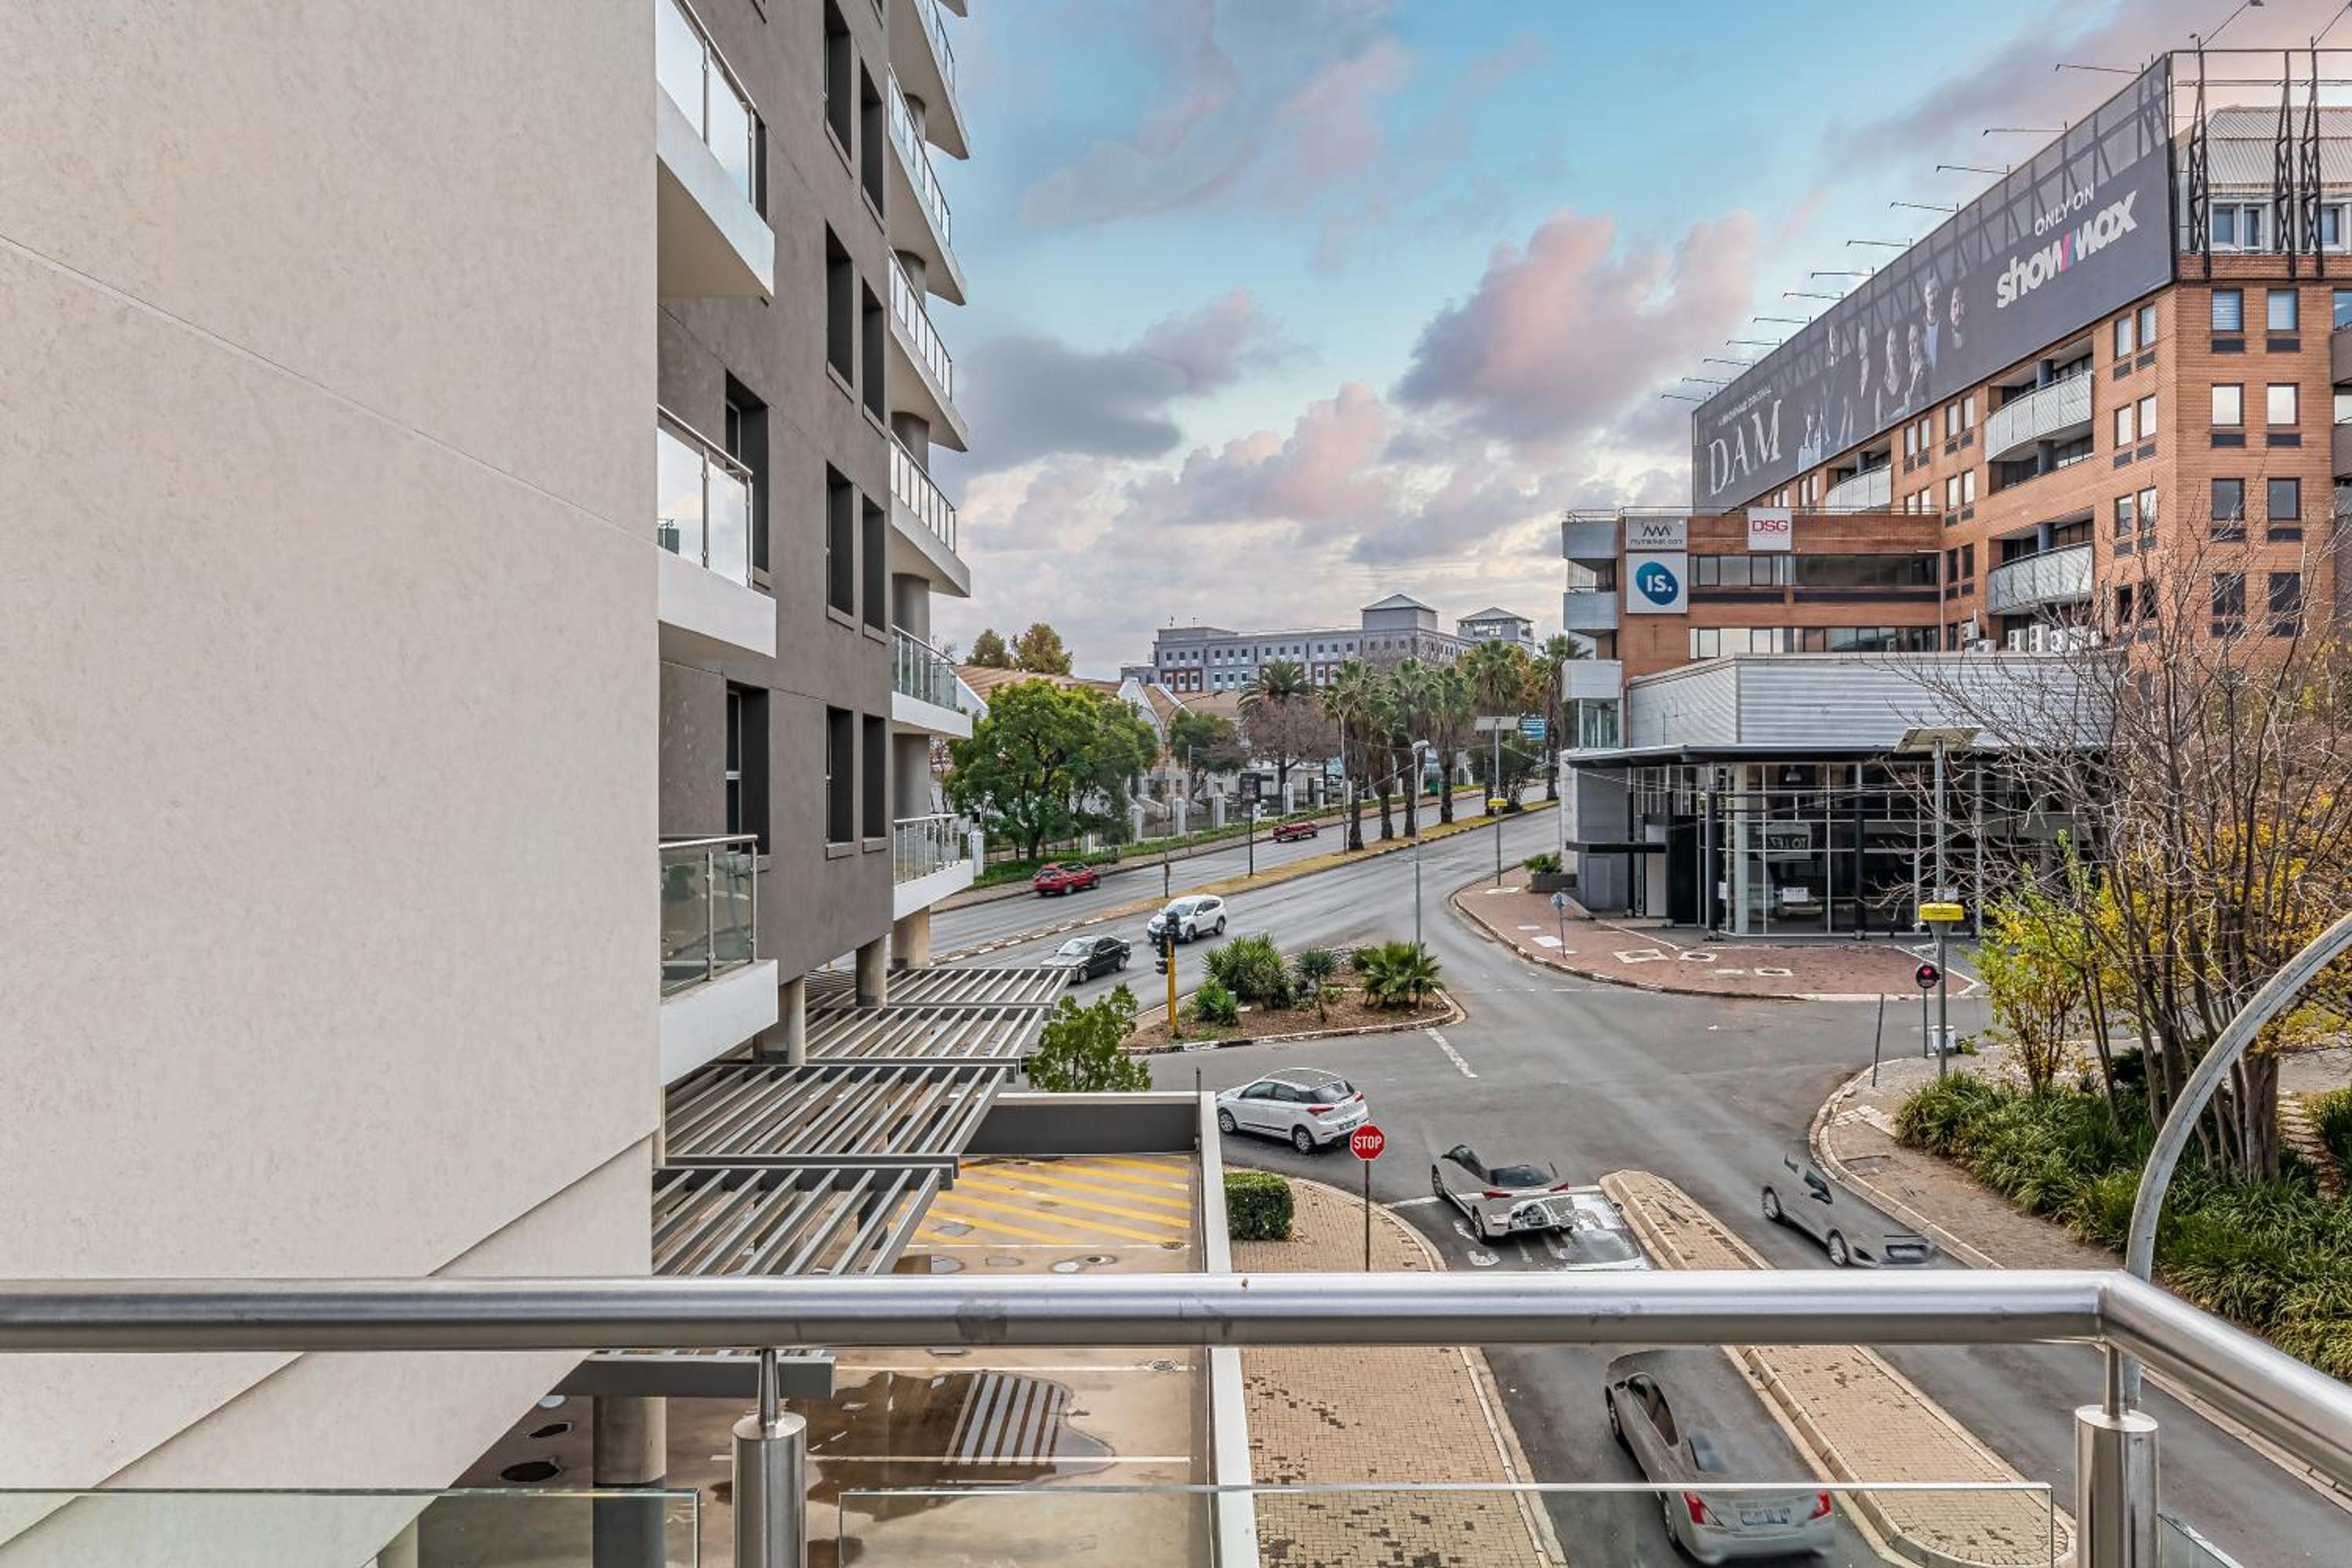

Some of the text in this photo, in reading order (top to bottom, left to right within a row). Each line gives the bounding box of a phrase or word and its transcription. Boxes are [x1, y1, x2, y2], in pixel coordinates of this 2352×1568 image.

[2034, 182, 2095, 236] ONLY ON
[1708, 399, 1782, 497] DAM
[1752, 520, 1788, 532] DSG
[1354, 1135, 1382, 1150] STOP
